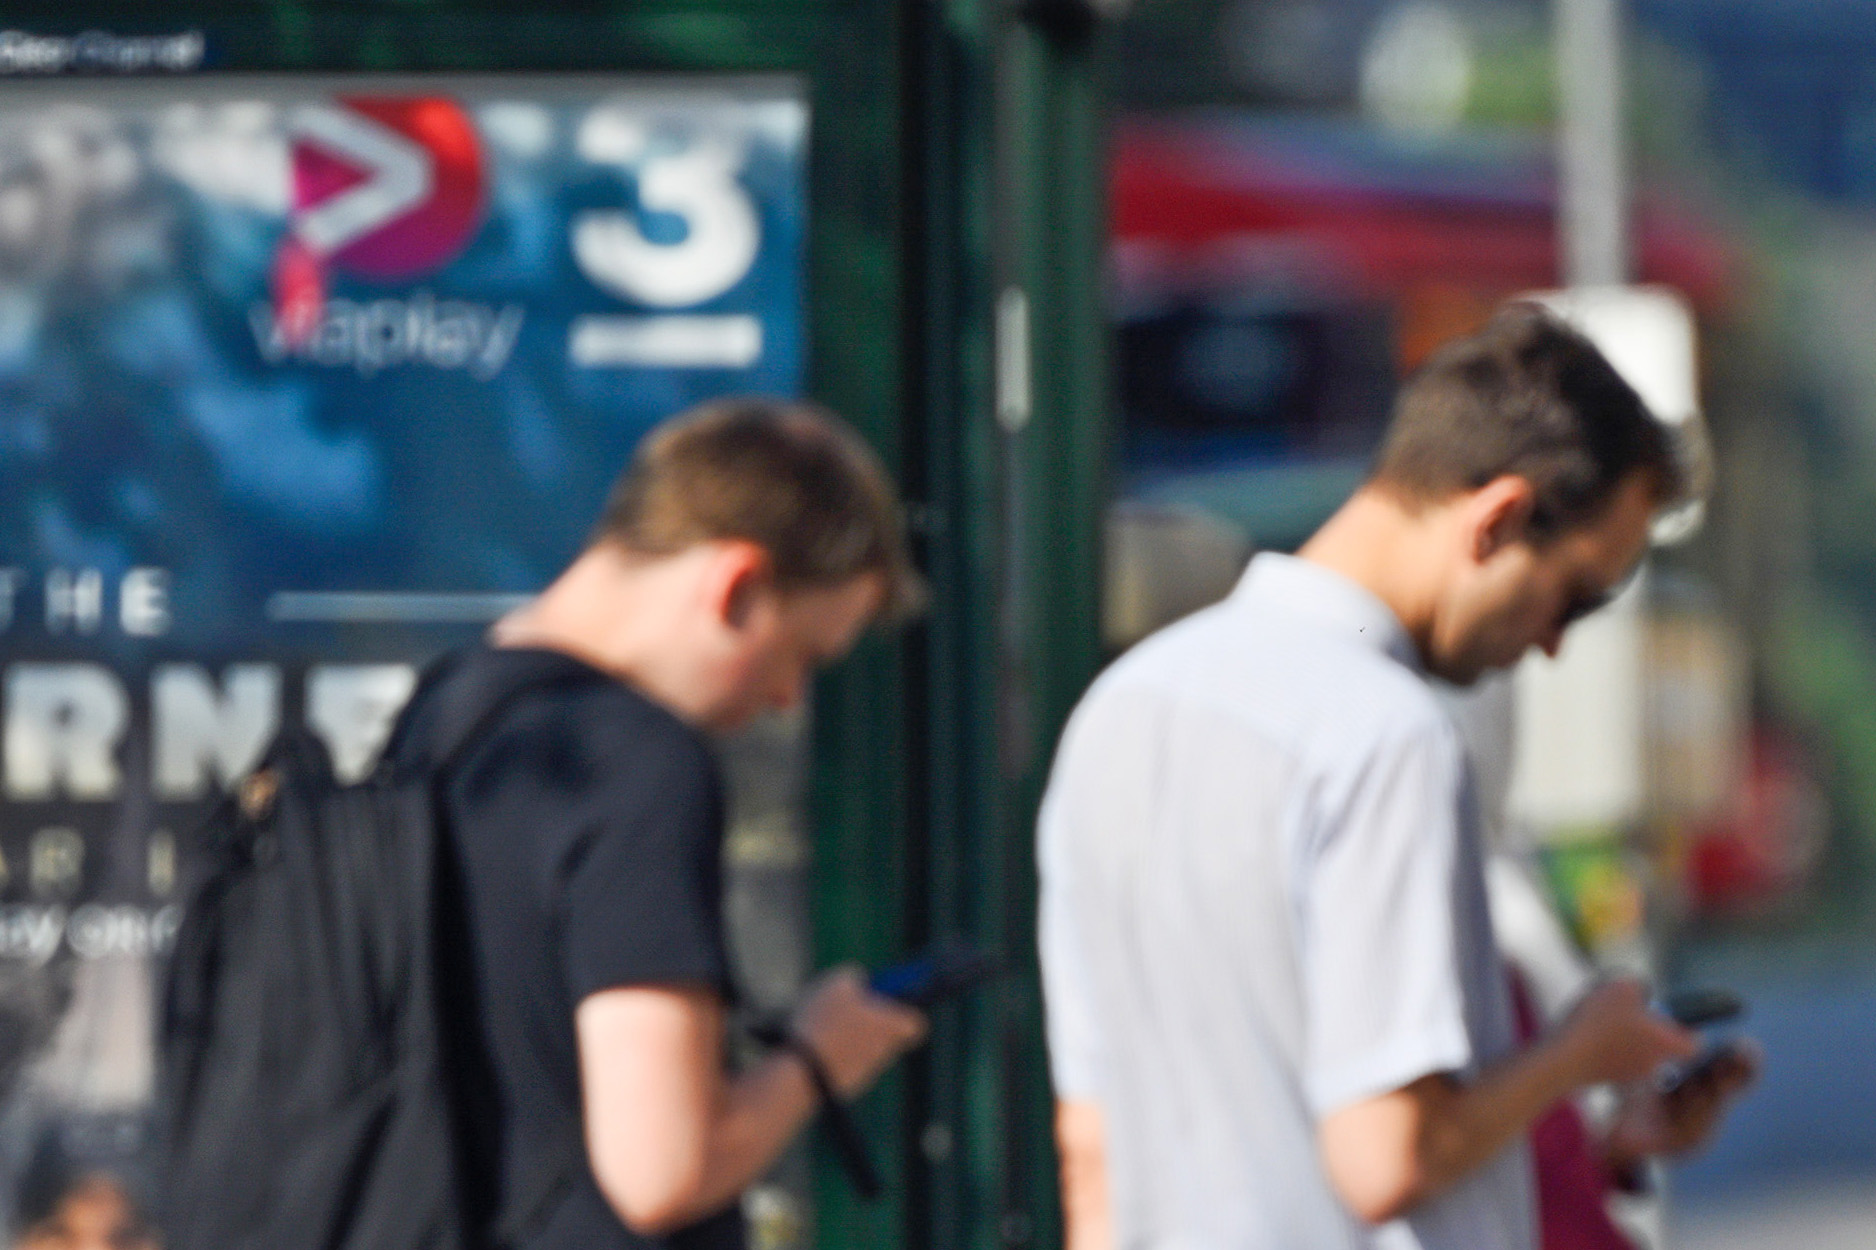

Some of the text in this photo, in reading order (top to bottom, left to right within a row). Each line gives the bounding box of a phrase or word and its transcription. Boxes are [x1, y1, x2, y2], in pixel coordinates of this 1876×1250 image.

[573, 104, 761, 308] 3
[250, 294, 525, 384] viaplay
[0, 568, 168, 635] THE
